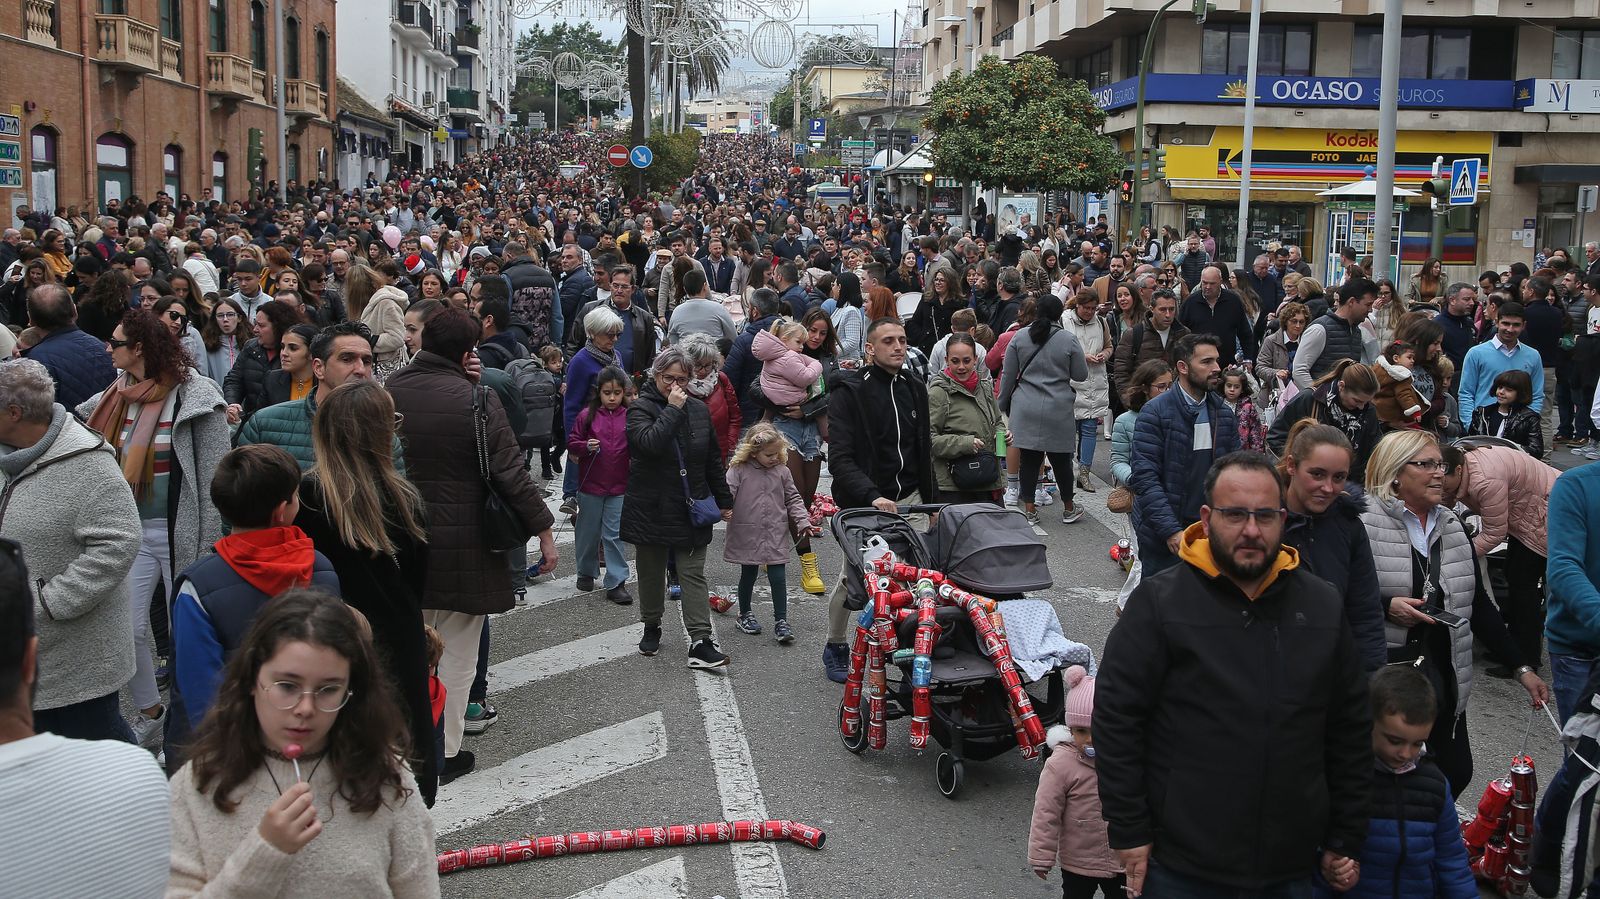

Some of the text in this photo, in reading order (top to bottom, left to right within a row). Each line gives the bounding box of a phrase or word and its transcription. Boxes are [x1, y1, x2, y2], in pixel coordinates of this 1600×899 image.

[1090, 88, 1113, 107] CASO
[1272, 80, 1445, 103] OCASO SGUROS
[814, 120, 821, 130] P
[1326, 132, 1378, 148] Kodak
[1311, 152, 1377, 163] FOTO JAE
